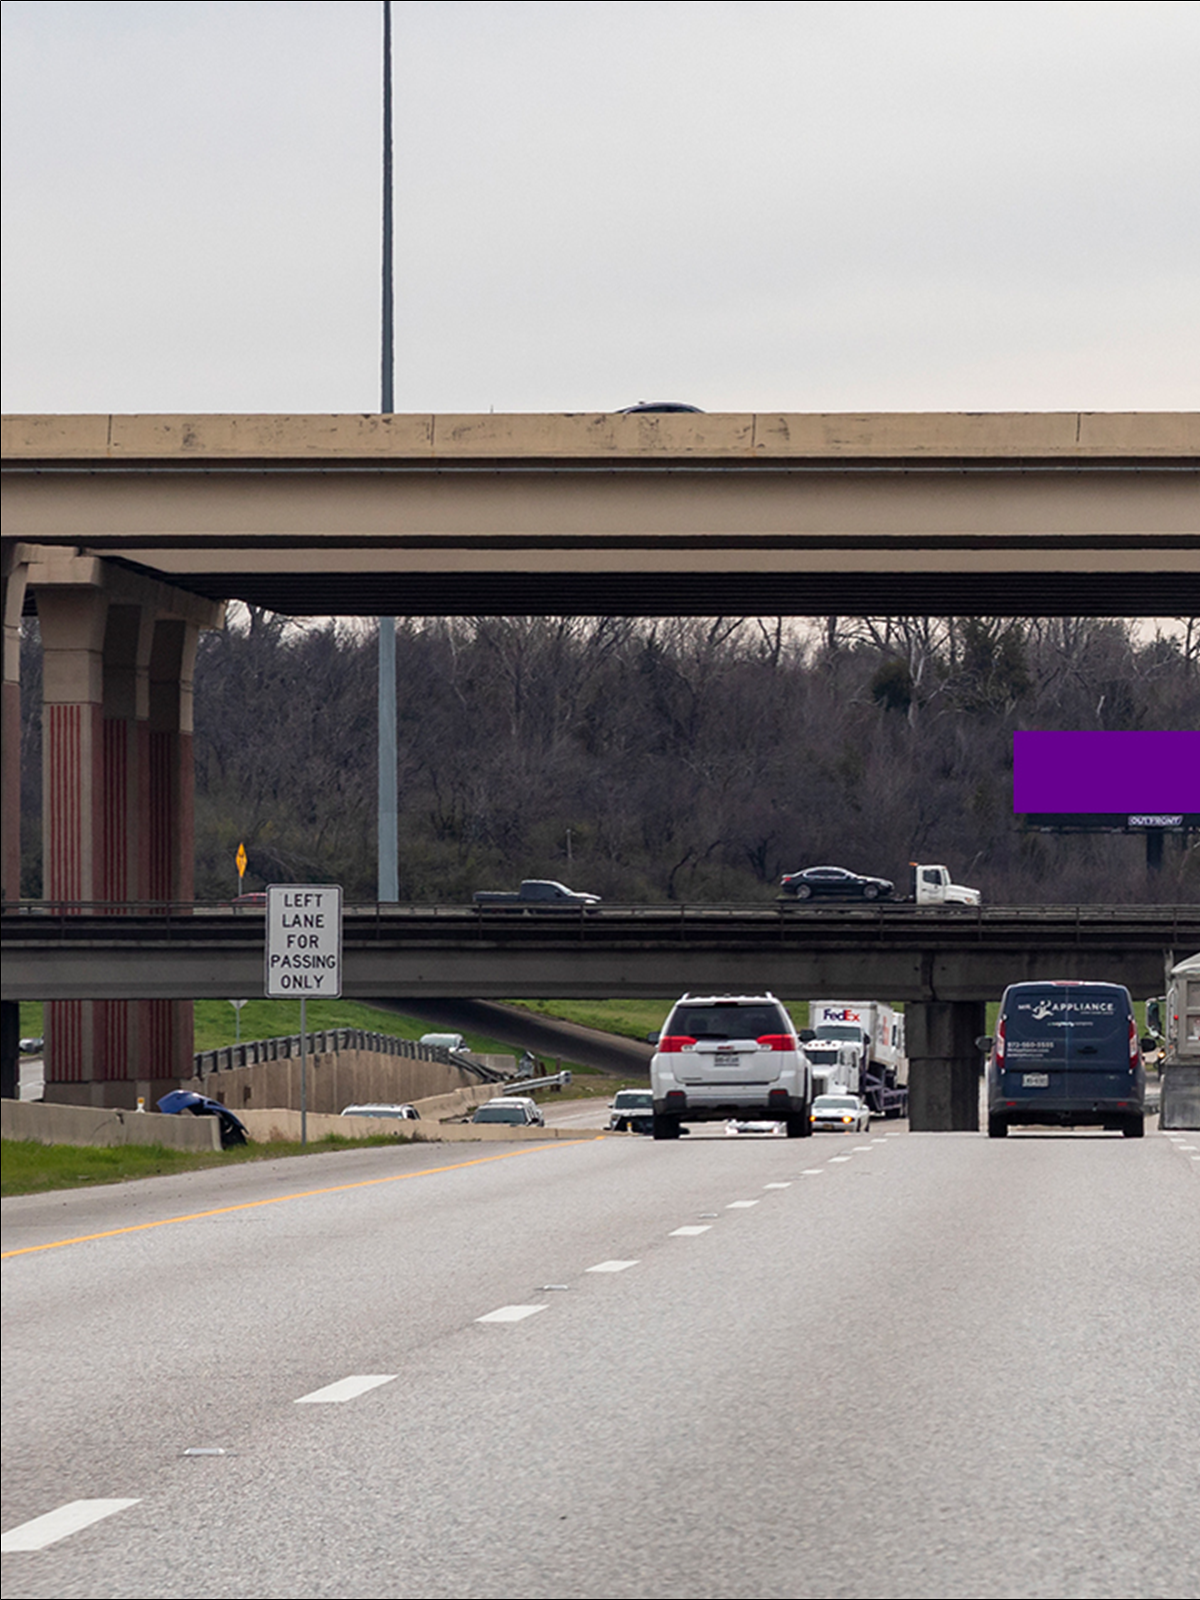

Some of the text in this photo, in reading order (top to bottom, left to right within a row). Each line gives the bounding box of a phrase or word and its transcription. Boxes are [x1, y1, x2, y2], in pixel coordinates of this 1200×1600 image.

[284, 893, 323, 908] LEFT
[282, 914, 325, 928] LANE
[286, 934, 320, 949] FOR
[270, 954, 336, 969] PASSING
[280, 974, 324, 989] ONLY
[1052, 1002, 1114, 1011] APPLIANCE
[823, 1008, 861, 1022] FedEx
